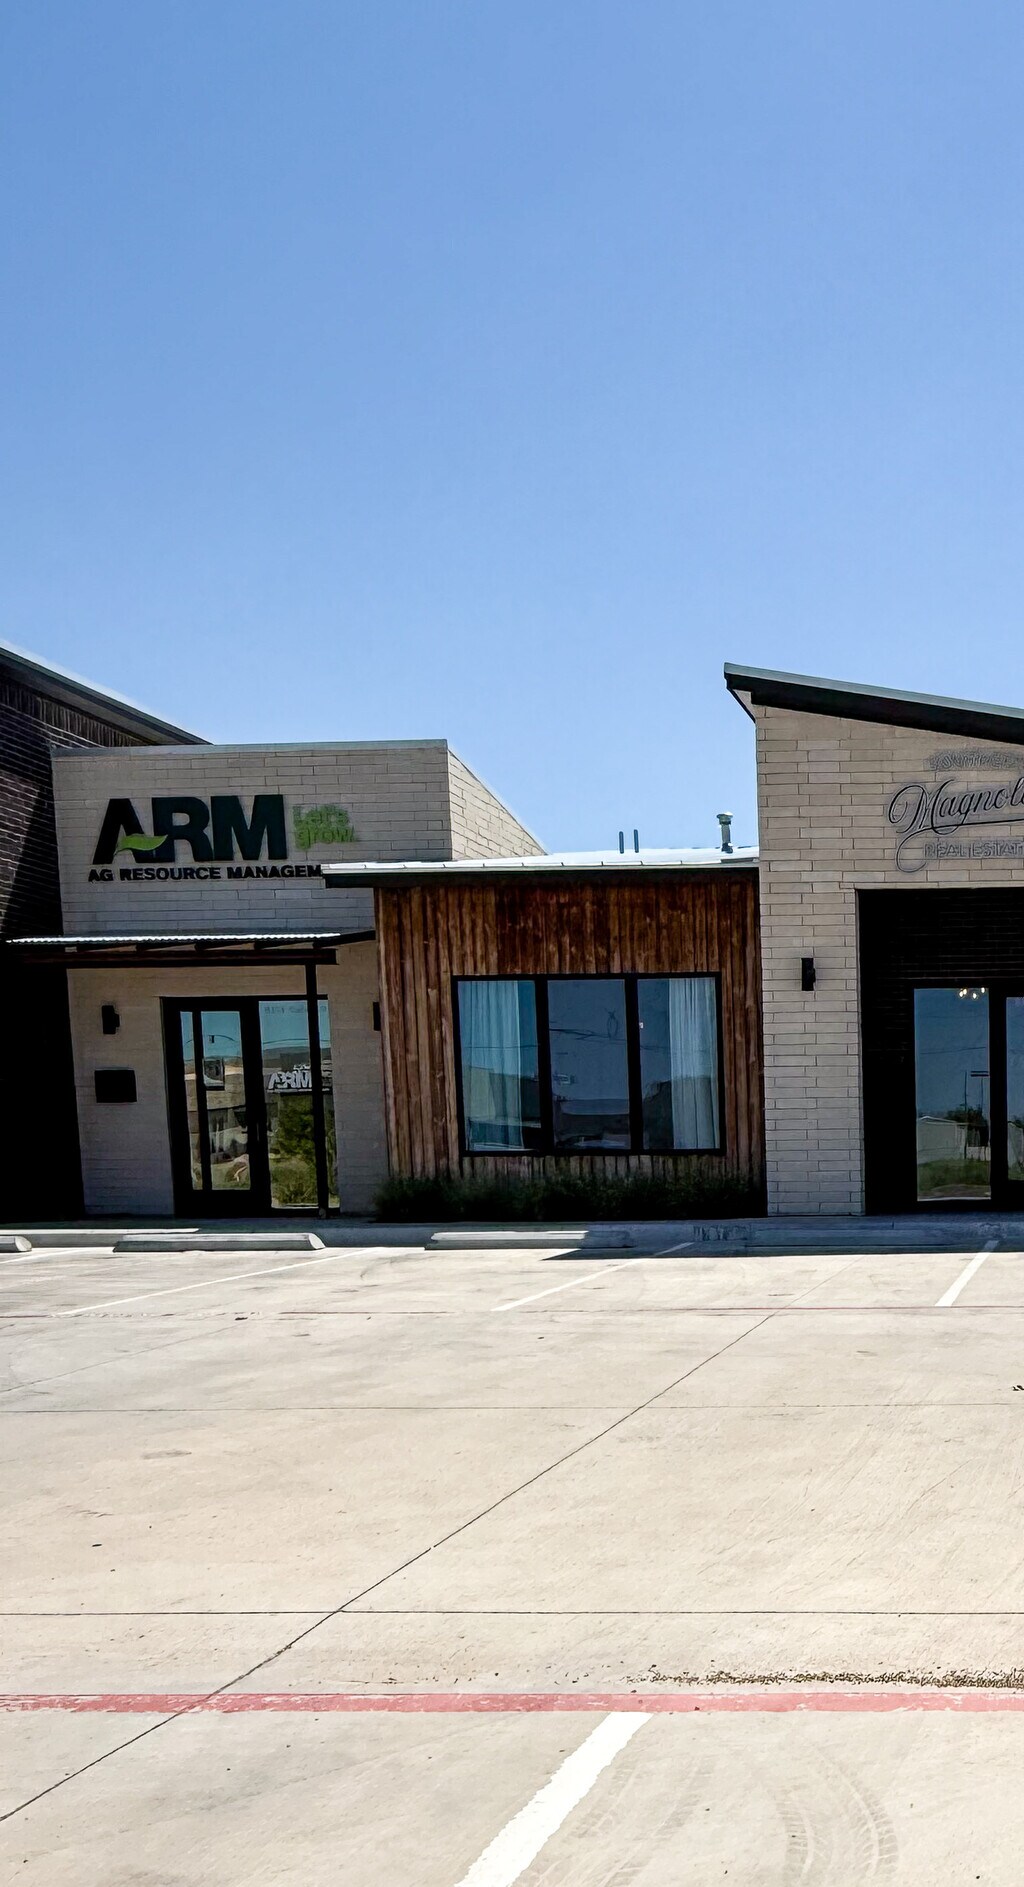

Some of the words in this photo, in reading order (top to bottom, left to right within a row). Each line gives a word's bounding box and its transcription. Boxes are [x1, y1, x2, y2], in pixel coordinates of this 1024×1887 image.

[92, 794, 288, 864] ARM
[924, 841, 969, 858] REAL
[88, 868, 114, 882] AG
[119, 866, 221, 881] RESOURCE
